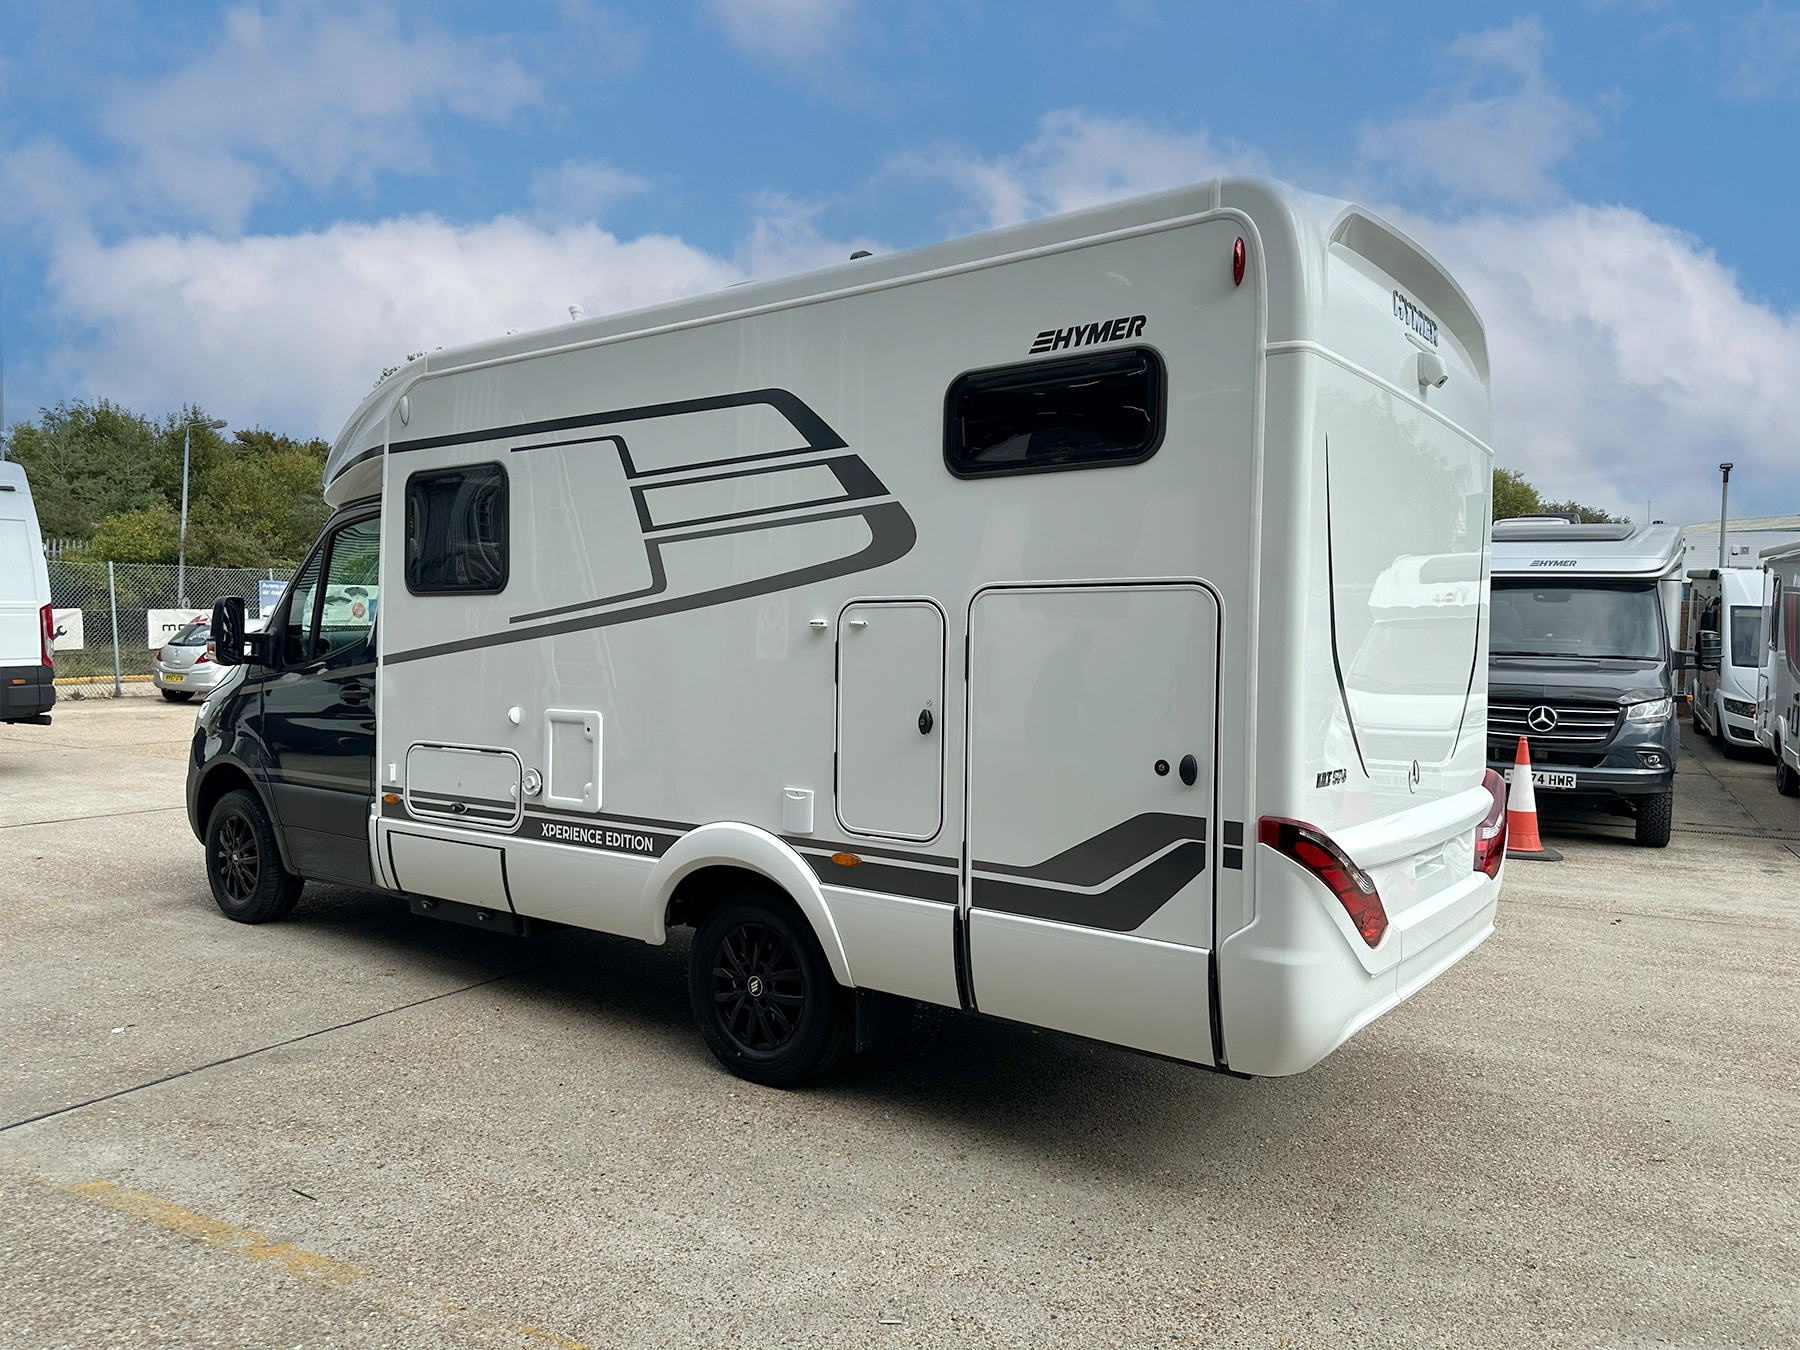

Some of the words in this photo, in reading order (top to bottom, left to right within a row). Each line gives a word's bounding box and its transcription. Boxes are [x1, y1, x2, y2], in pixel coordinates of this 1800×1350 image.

[1050, 315, 1147, 352] HYMER
[1549, 774, 1574, 787] HWR
[541, 822, 603, 845] XPERIENCE
[605, 831, 653, 852] EDITION
